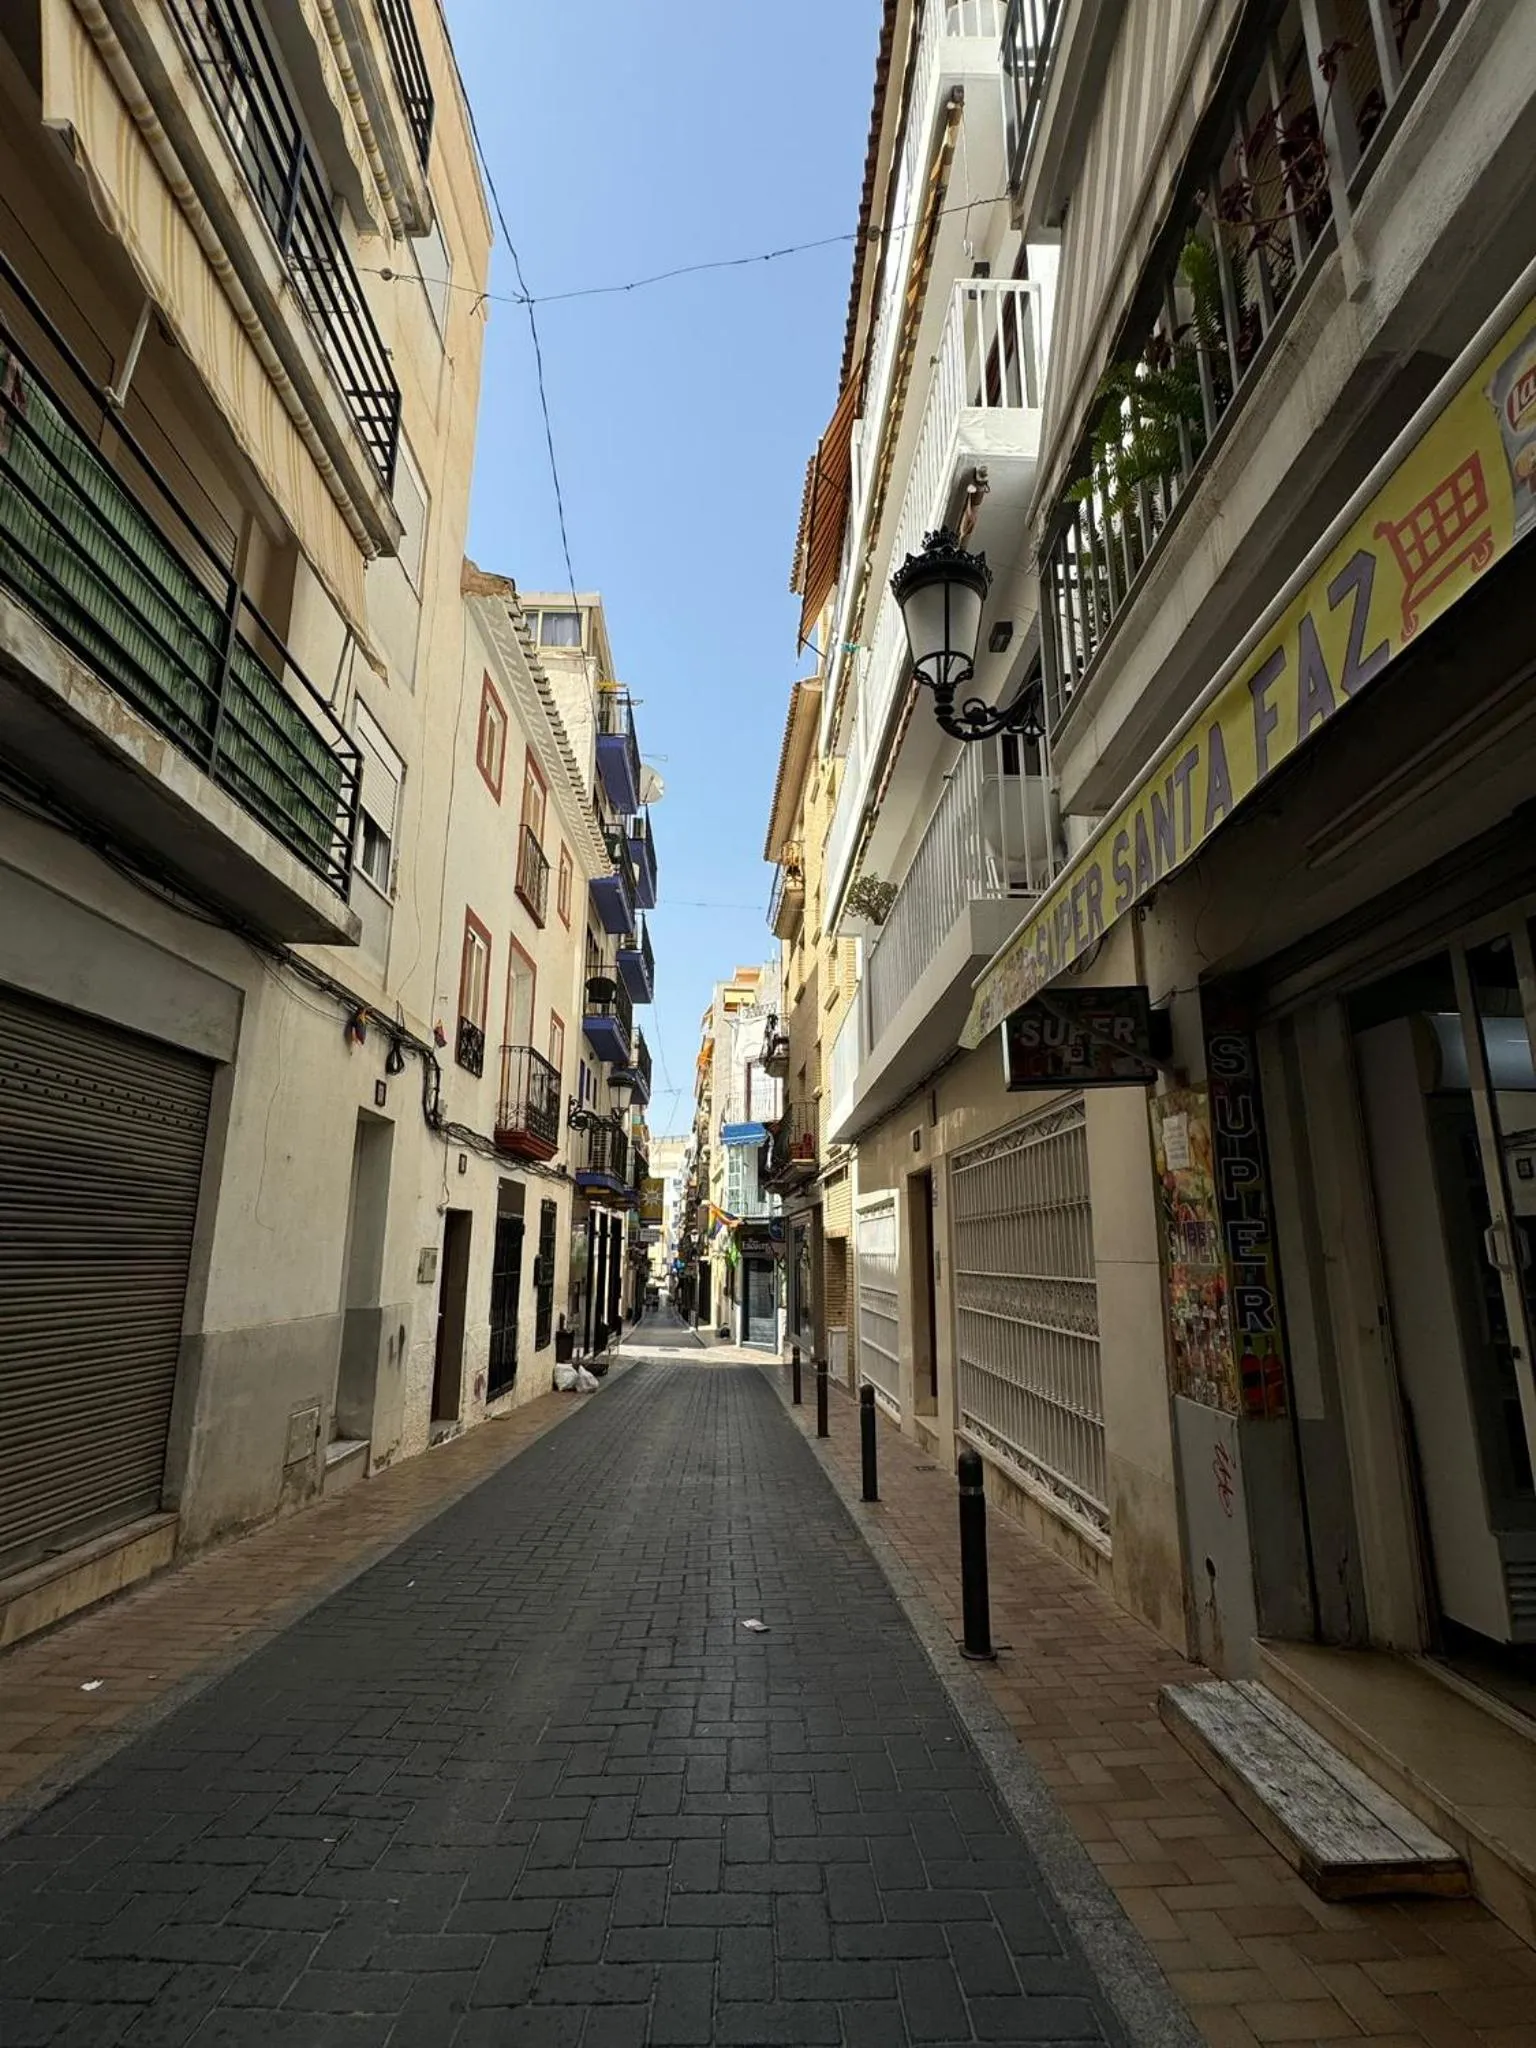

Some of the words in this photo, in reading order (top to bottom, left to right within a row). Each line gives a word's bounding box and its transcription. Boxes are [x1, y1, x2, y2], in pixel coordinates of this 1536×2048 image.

[1035, 863, 1105, 979] SUPER
[1112, 720, 1234, 913] SANTA
[1248, 549, 1391, 779] FAZ
[1209, 1035, 1276, 1333] SUPER
